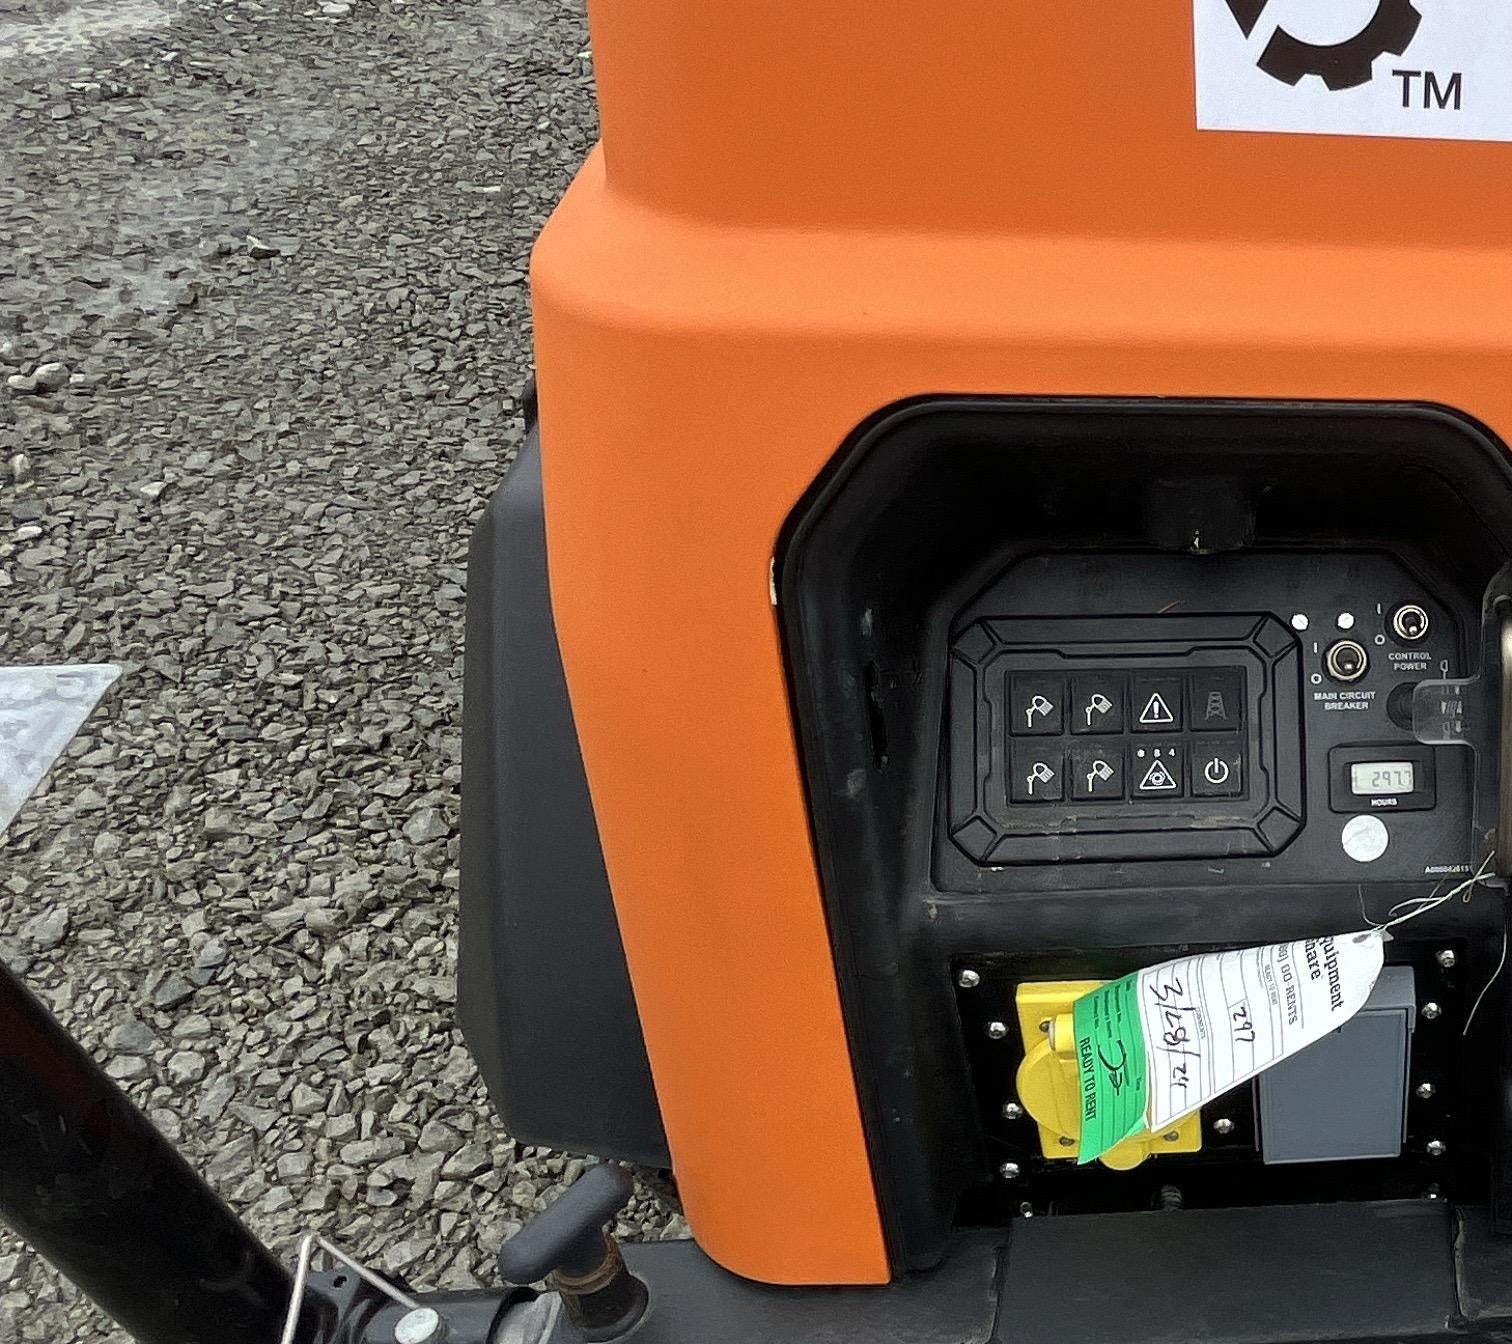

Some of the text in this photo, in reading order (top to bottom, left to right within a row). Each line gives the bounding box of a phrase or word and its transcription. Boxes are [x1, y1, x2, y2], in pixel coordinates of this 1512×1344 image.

[1392, 69, 1463, 110] TM
[1388, 652, 1432, 660] CONTROL
[1314, 691, 1376, 700] MAIN CIRCUIT
[1324, 702, 1369, 710] BREAKER
[1371, 798, 1397, 806] HOURS
[1232, 1006, 1256, 1043] 297
[1080, 1036, 1098, 1122] READY TO RENT
